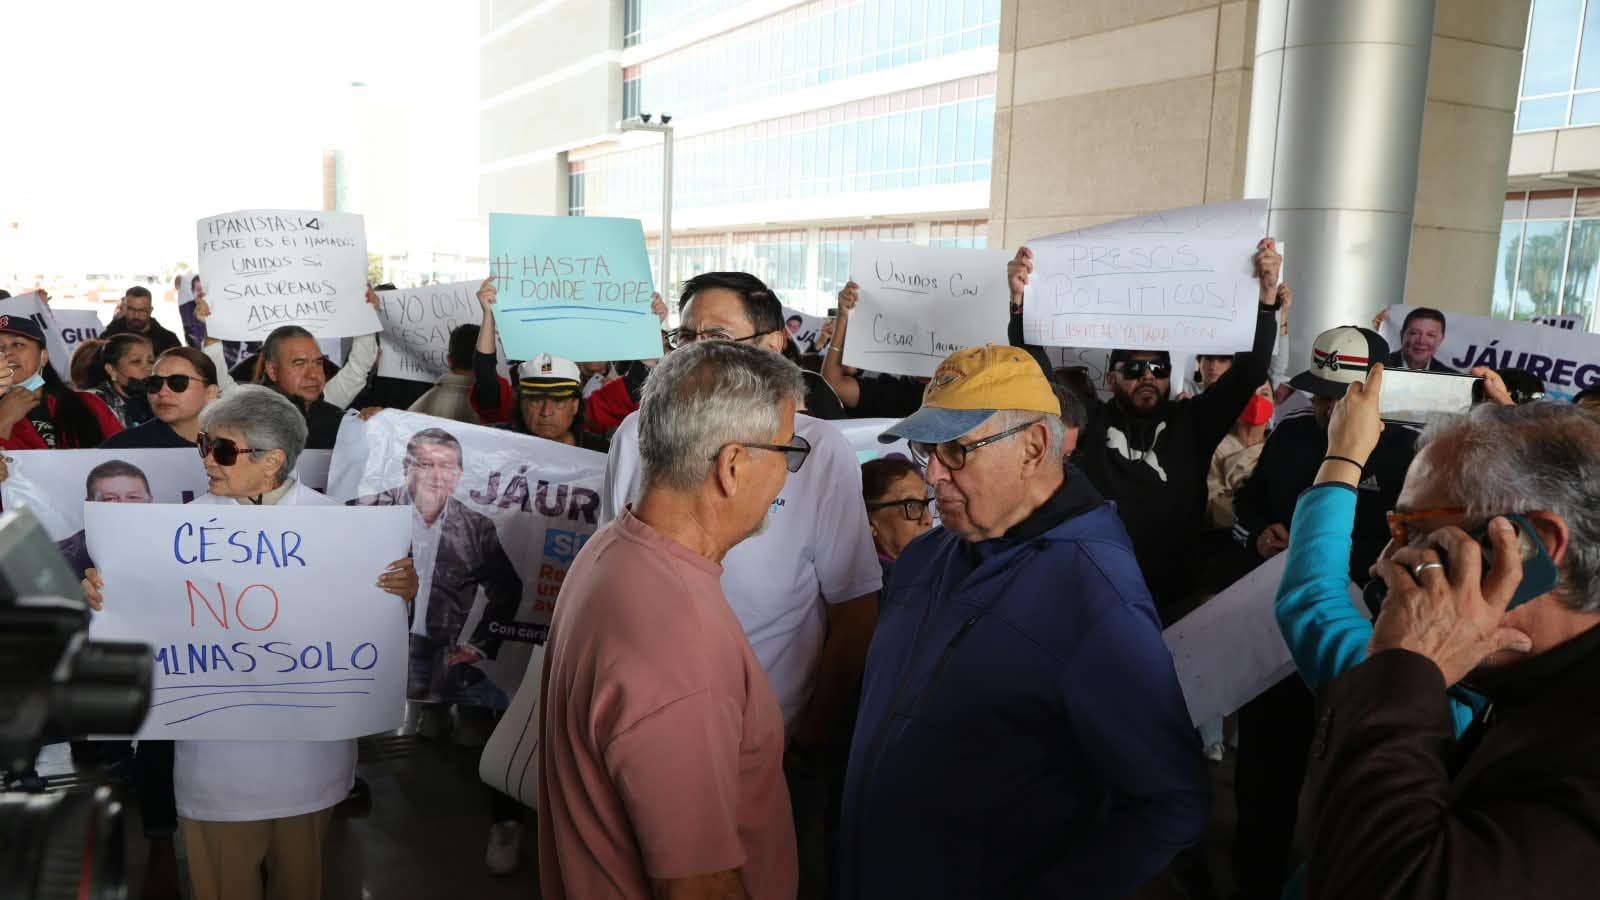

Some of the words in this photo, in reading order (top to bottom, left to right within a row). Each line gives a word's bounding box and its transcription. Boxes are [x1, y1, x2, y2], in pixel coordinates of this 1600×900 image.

[254, 236, 274, 248] ES
[231, 256, 292, 272] UNIDOS
[1056, 241, 1200, 273] PRESOS
[875, 257, 938, 289] UNIDOS
[224, 280, 337, 300] SALDREMOS
[431, 287, 474, 320] CON
[521, 279, 585, 300] DONDE
[593, 281, 650, 304] TOPE
[247, 300, 337, 324] ADELANTE
[173, 518, 306, 567] CÉSAR
[185, 580, 279, 631] NO
